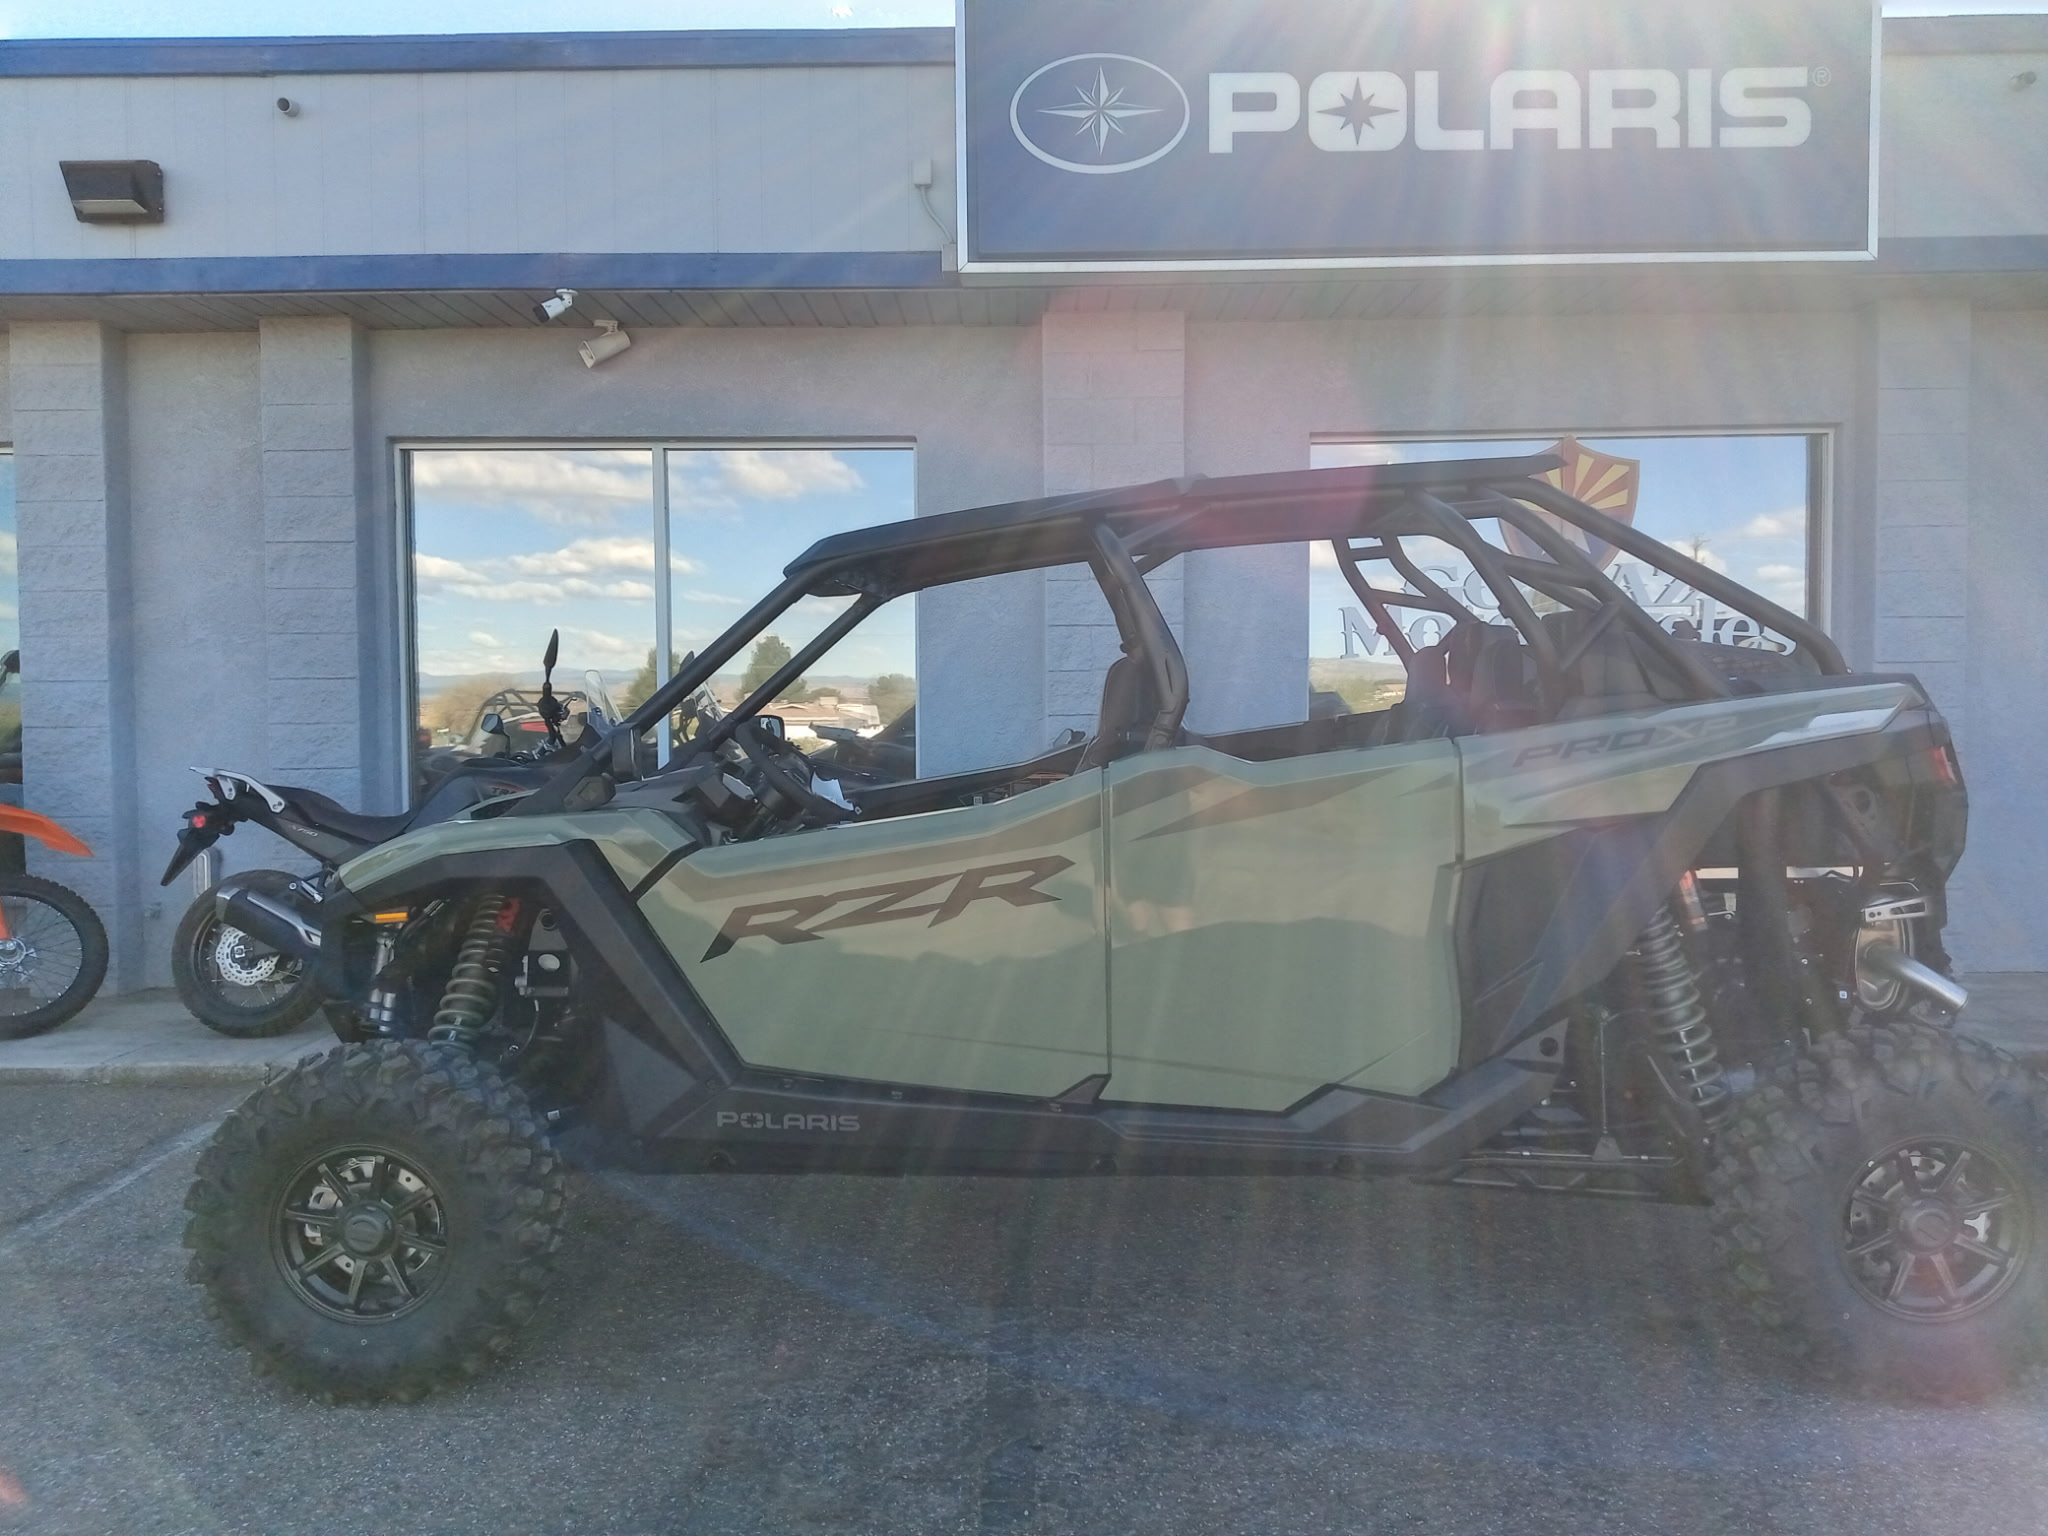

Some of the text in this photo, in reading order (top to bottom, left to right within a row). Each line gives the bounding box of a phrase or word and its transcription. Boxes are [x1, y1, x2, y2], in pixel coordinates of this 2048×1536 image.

[1208, 66, 1812, 154] POLARIS
[700, 854, 1076, 963] RZR
[716, 1111, 861, 1132] POLARIS
